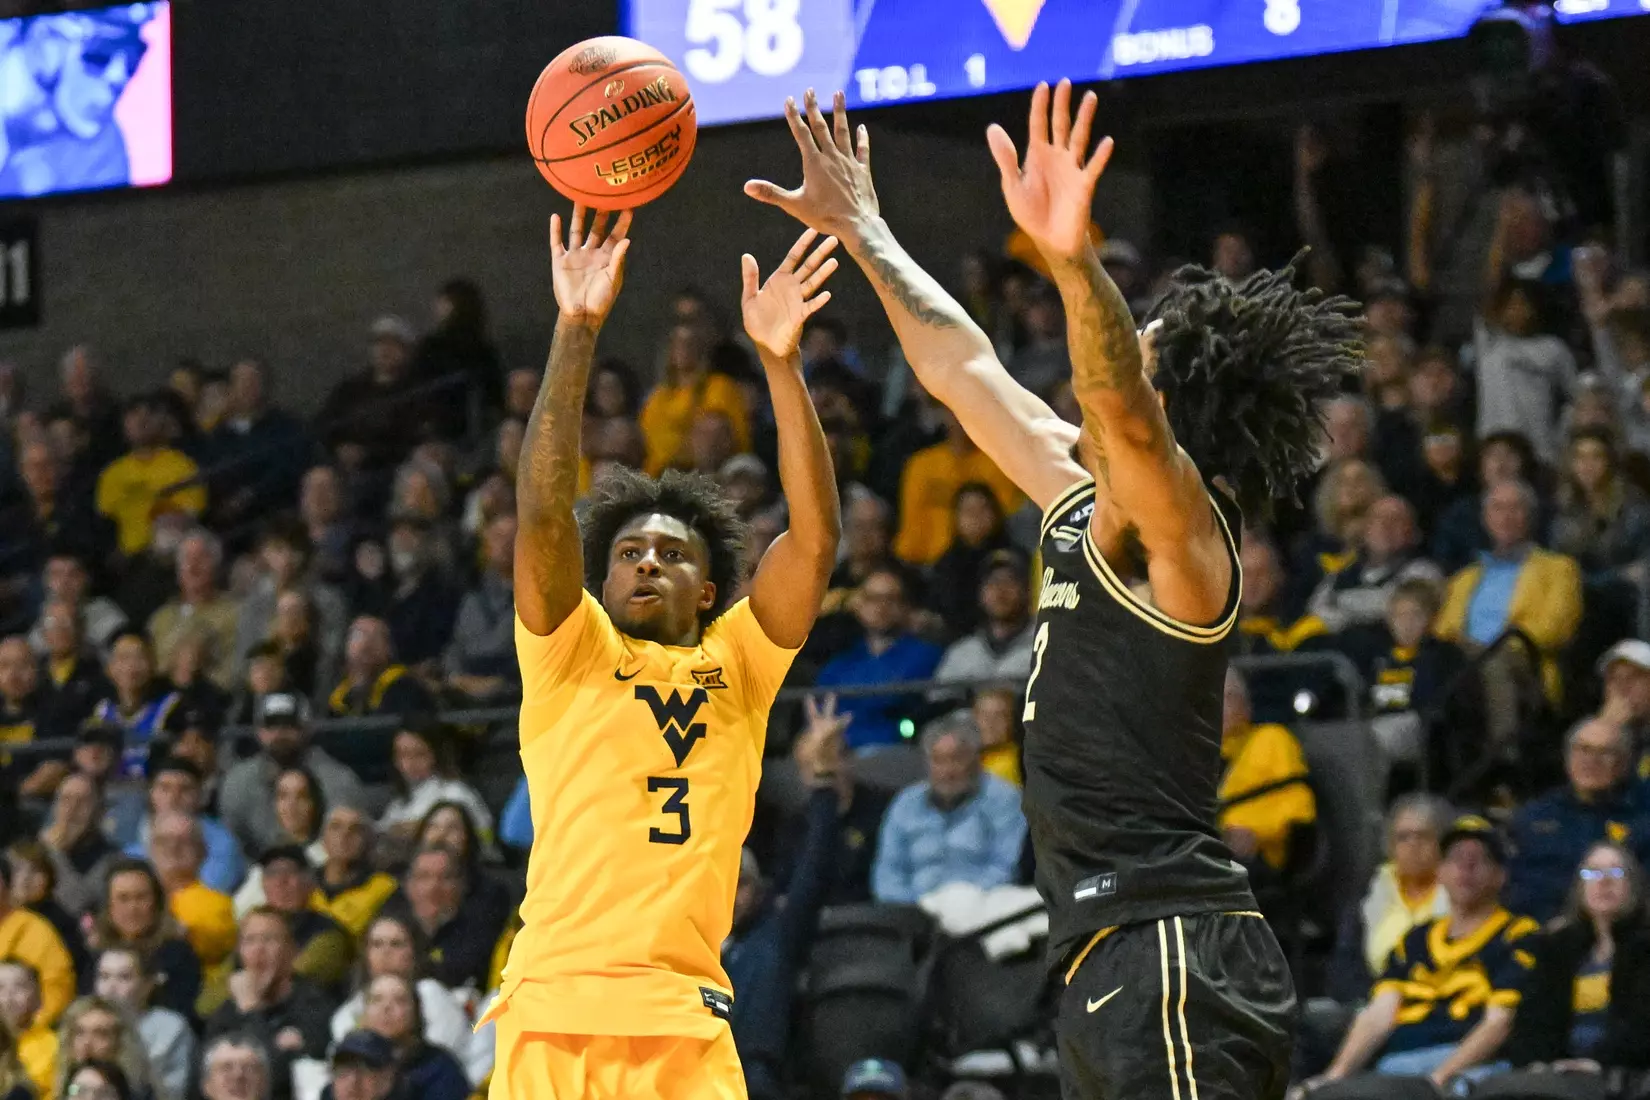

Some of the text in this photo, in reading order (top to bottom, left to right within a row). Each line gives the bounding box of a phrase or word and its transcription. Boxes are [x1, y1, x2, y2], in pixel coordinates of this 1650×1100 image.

[684, 0, 803, 83] 58
[964, 53, 986, 88] 1
[569, 75, 678, 147] SPALDING
[594, 123, 682, 178] LEGACY
[1022, 621, 1050, 723] 2
[647, 776, 691, 845] 3
[1101, 878, 1112, 889] M
